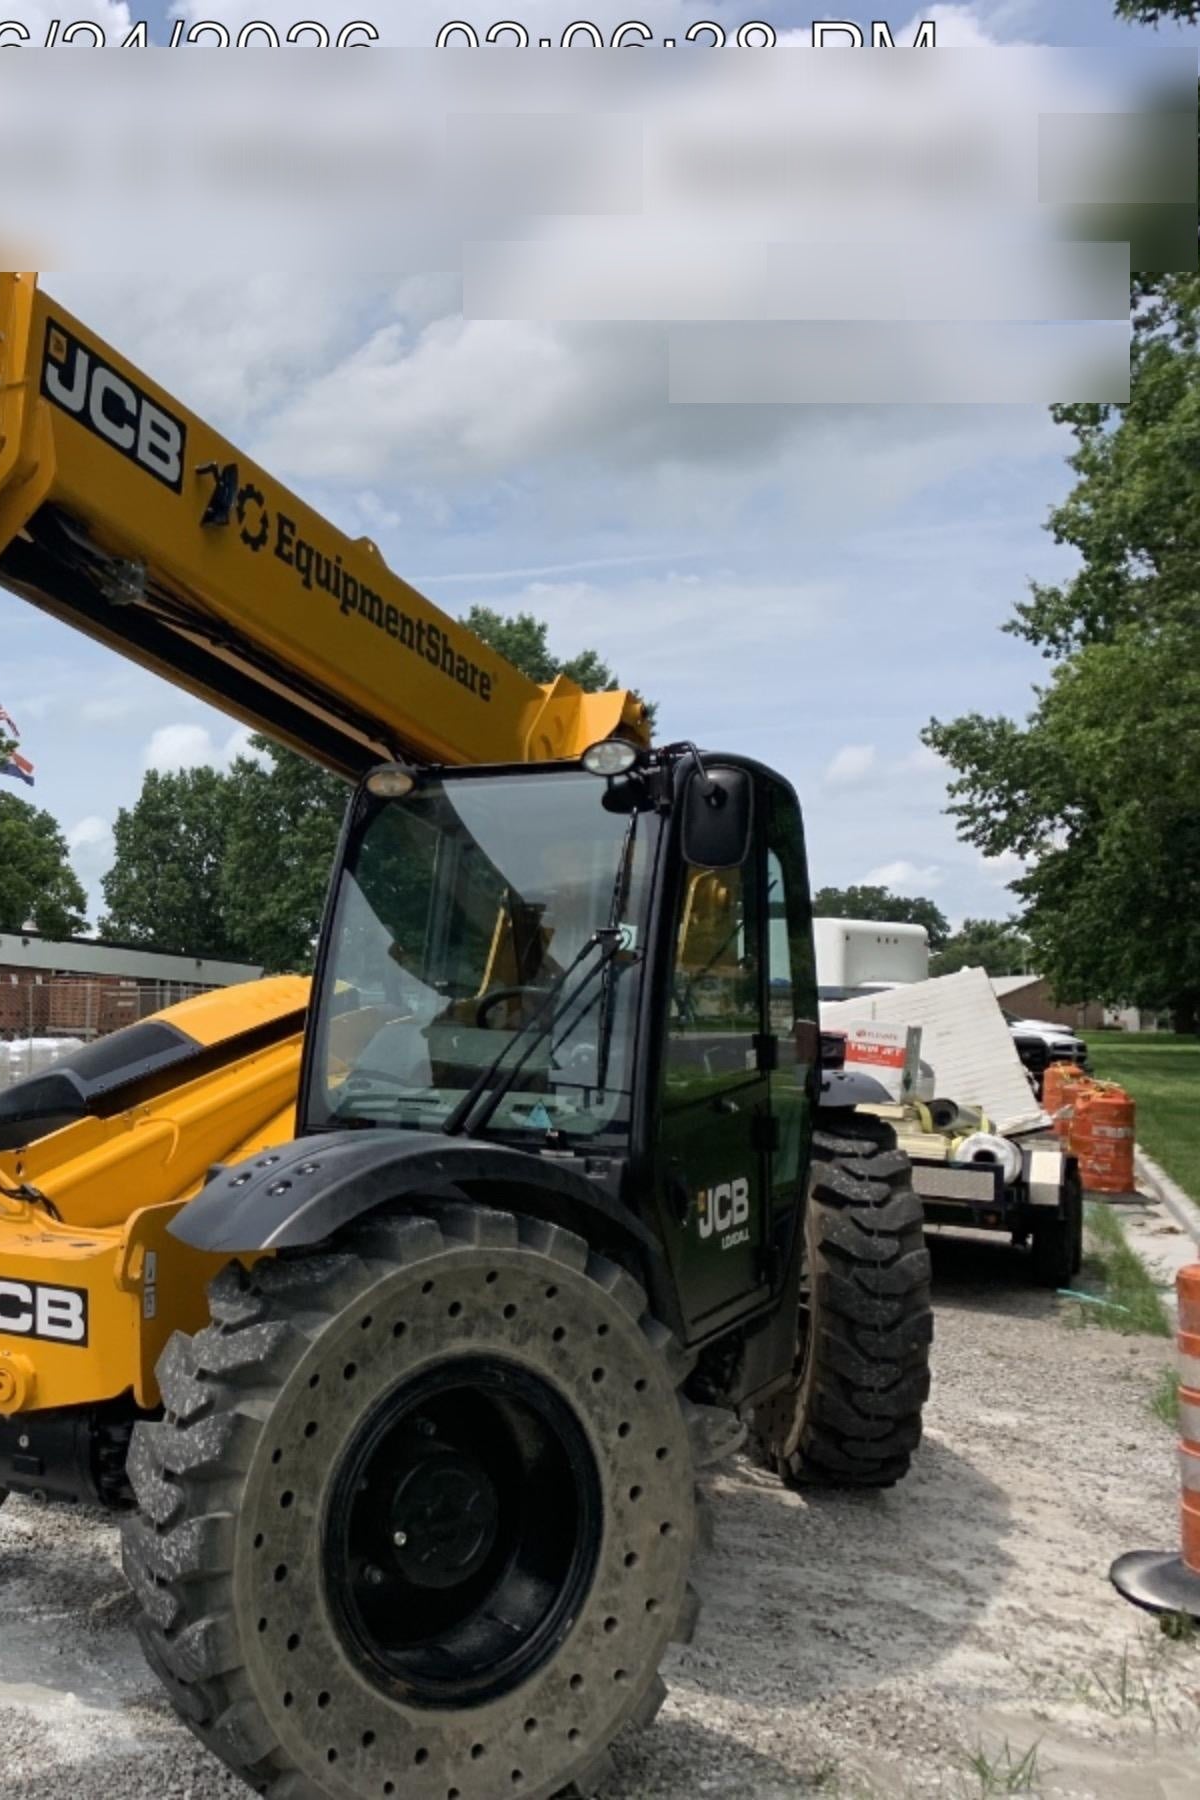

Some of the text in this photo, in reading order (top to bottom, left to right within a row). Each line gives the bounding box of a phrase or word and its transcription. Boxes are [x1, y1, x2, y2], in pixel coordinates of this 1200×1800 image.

[45, 347, 183, 484] JCB
[273, 512, 491, 702] EquipmentShare
[698, 1177, 749, 1239] JCB
